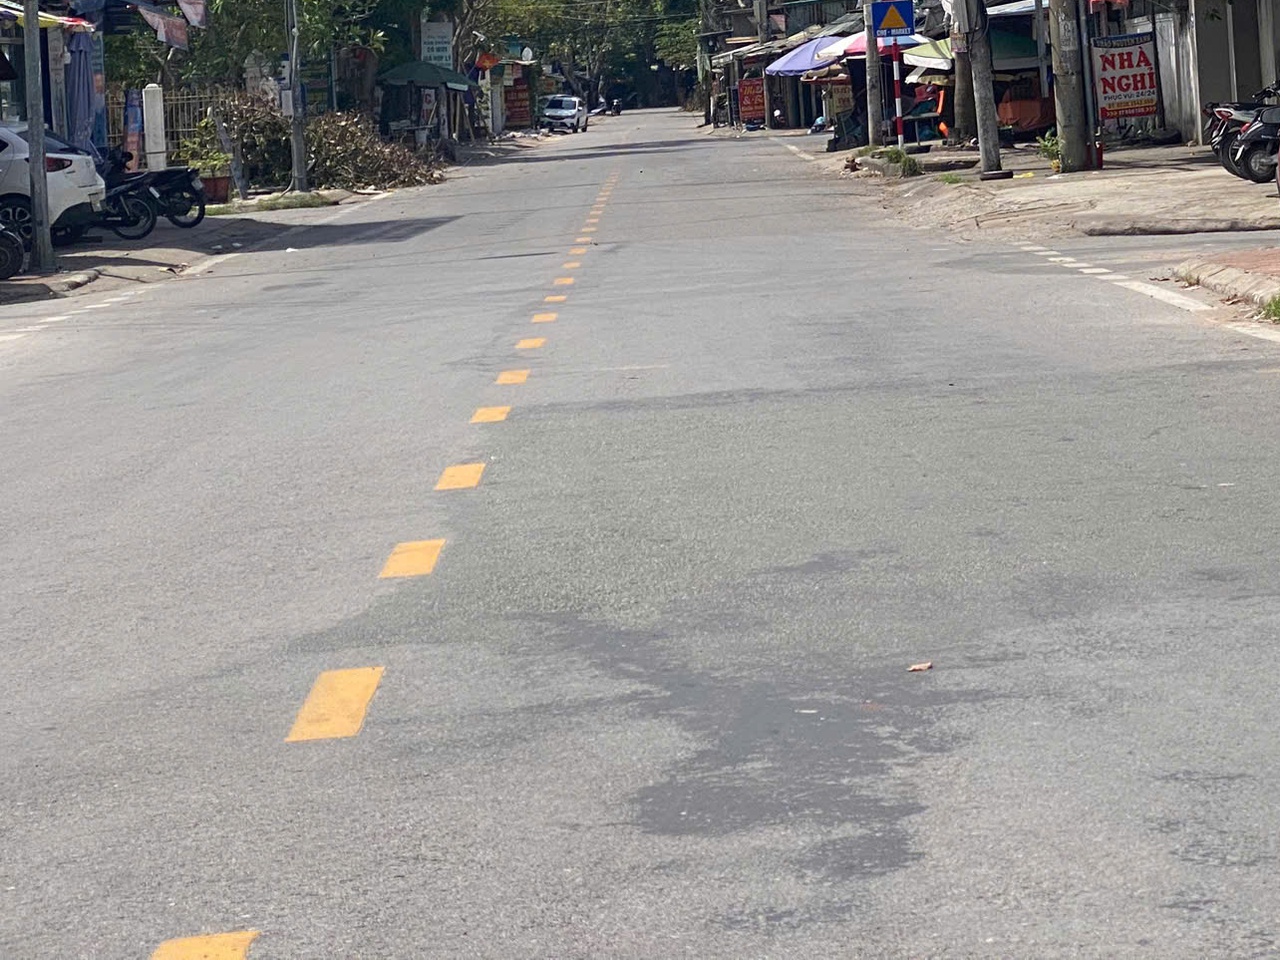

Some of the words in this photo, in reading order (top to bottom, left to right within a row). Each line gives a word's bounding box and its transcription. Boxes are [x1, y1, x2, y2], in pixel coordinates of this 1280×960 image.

[1099, 46, 1152, 71] NHÀ
[1100, 67, 1156, 94] NGHỈ
[1136, 90, 1156, 98] 24/24
